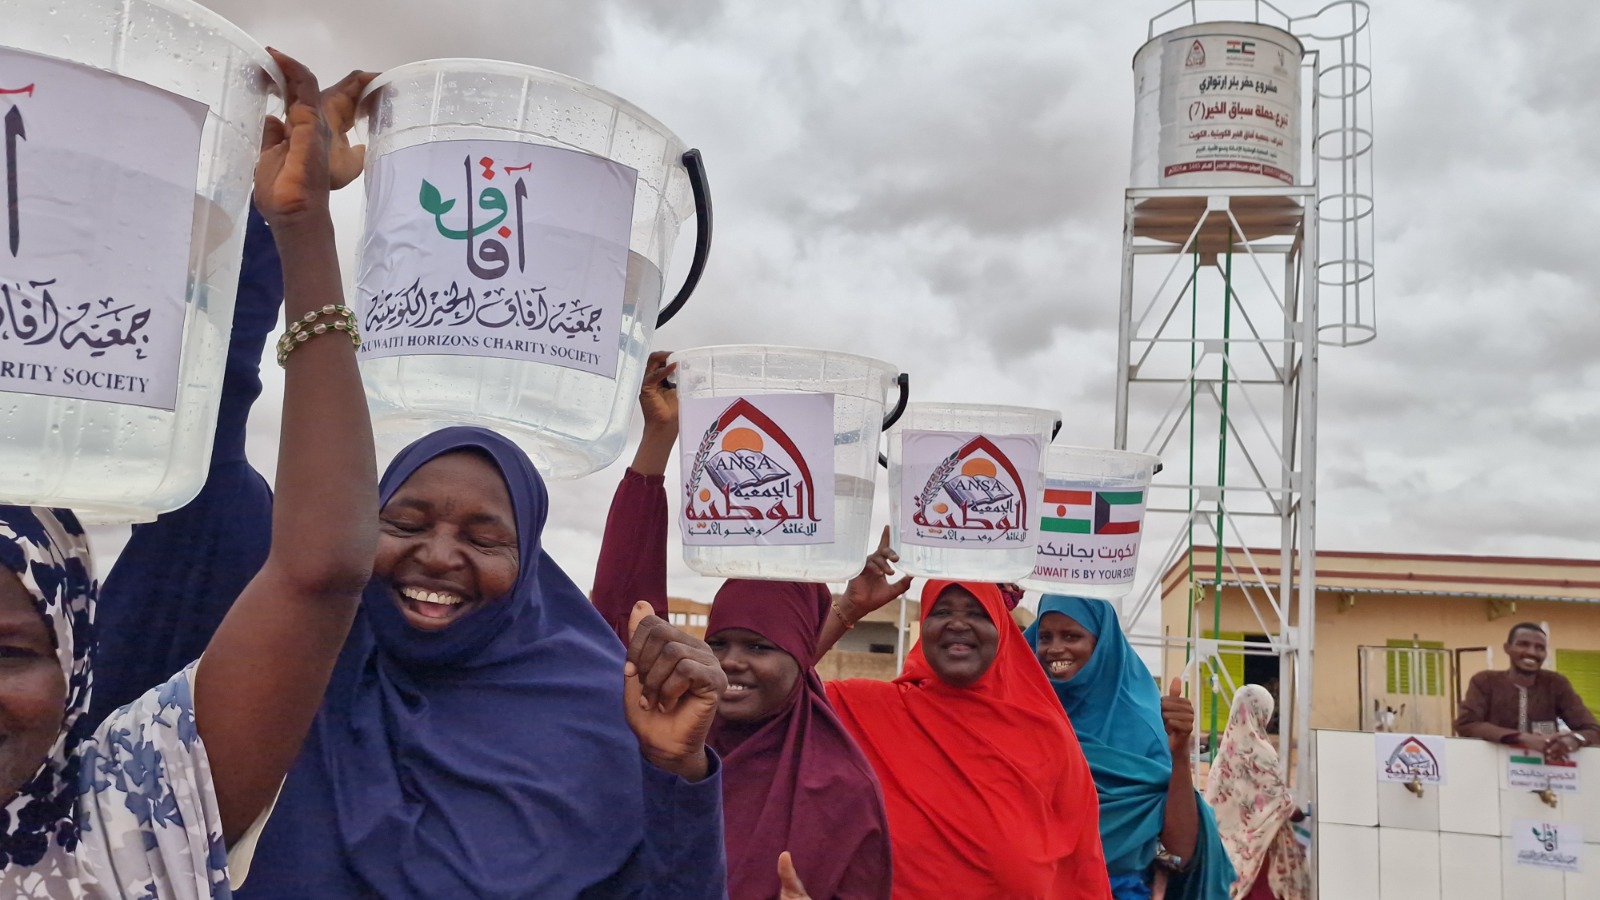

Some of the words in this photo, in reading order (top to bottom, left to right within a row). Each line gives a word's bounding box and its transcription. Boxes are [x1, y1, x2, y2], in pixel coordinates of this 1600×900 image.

[1228, 75, 1239, 90] بئر
[1240, 76, 1254, 90] حفر
[1255, 79, 1277, 94] مشروع
[1228, 102, 1253, 119] سباق
[1255, 104, 1275, 120] حملة
[0, 278, 59, 345] آفا
[365, 277, 428, 332] الكويتية
[414, 280, 476, 328] الخير
[475, 286, 548, 331] آفاق
[59, 297, 151, 360] جمعية
[548, 299, 603, 342] جمعية
[361, 335, 404, 353] KUWAITI
[407, 334, 479, 347] HORIZONS
[483, 337, 548, 355] CHARITY
[550, 345, 601, 365] SOCIETY
[0, 361, 57, 382] RITY
[62, 367, 150, 393] SOCIETY
[715, 455, 774, 471] ANSA
[734, 479, 793, 500] الجمعية
[955, 480, 1002, 492] ANSA
[970, 498, 1014, 515] الجمعية
[1097, 543, 1137, 563] الكويت
[1071, 569, 1080, 579] IS
[1083, 569, 1096, 579] BY
[1099, 569, 1122, 579] YOUR
[1123, 567, 1134, 578] SIDE
